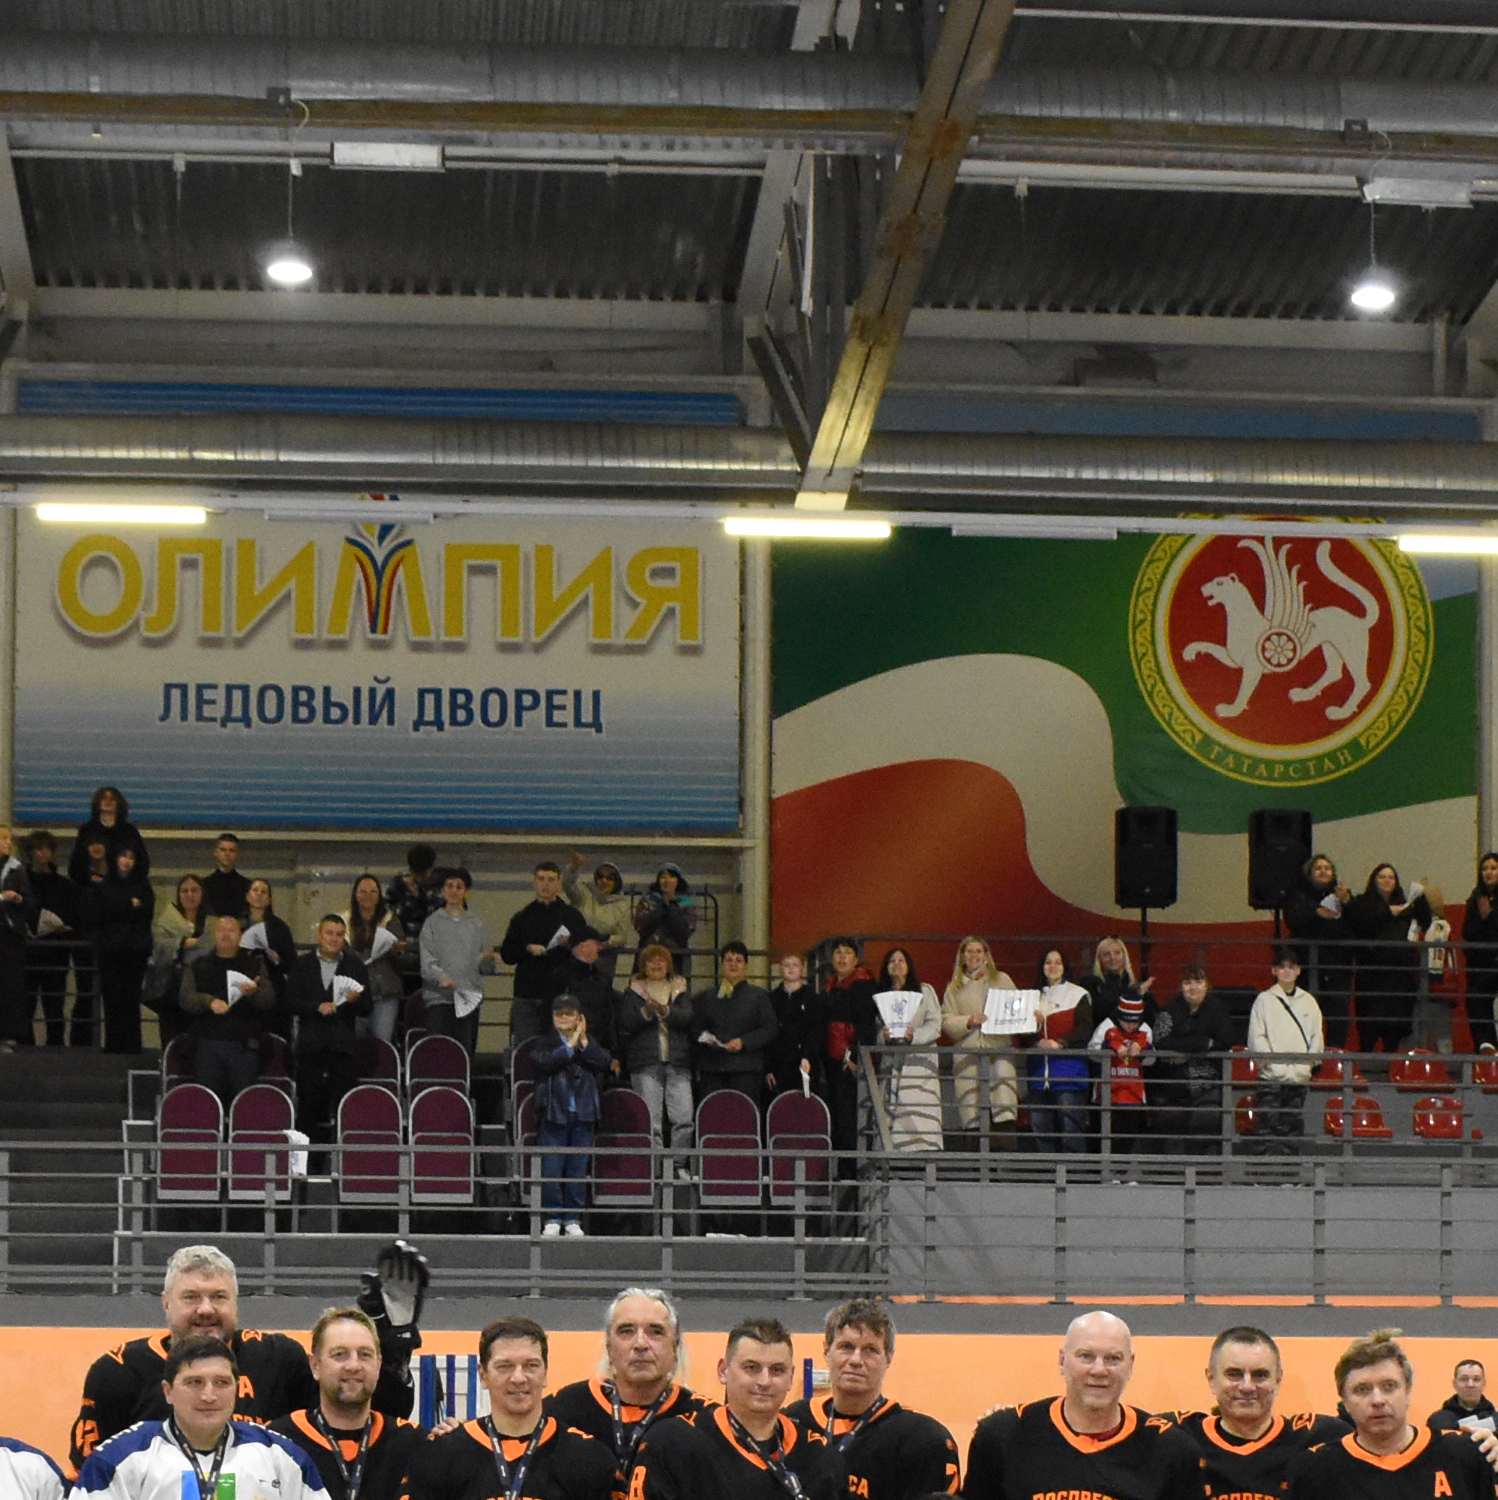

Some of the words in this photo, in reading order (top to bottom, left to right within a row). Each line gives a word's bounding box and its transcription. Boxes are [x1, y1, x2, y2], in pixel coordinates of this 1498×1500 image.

[57, 534, 700, 641] ОЛИМПИЯ
[158, 677, 397, 727] ЛЕДОВЫЙ
[412, 686, 603, 733] ДВОРЕЦ
[1208, 745, 1352, 779] ТАТАРСТАН
